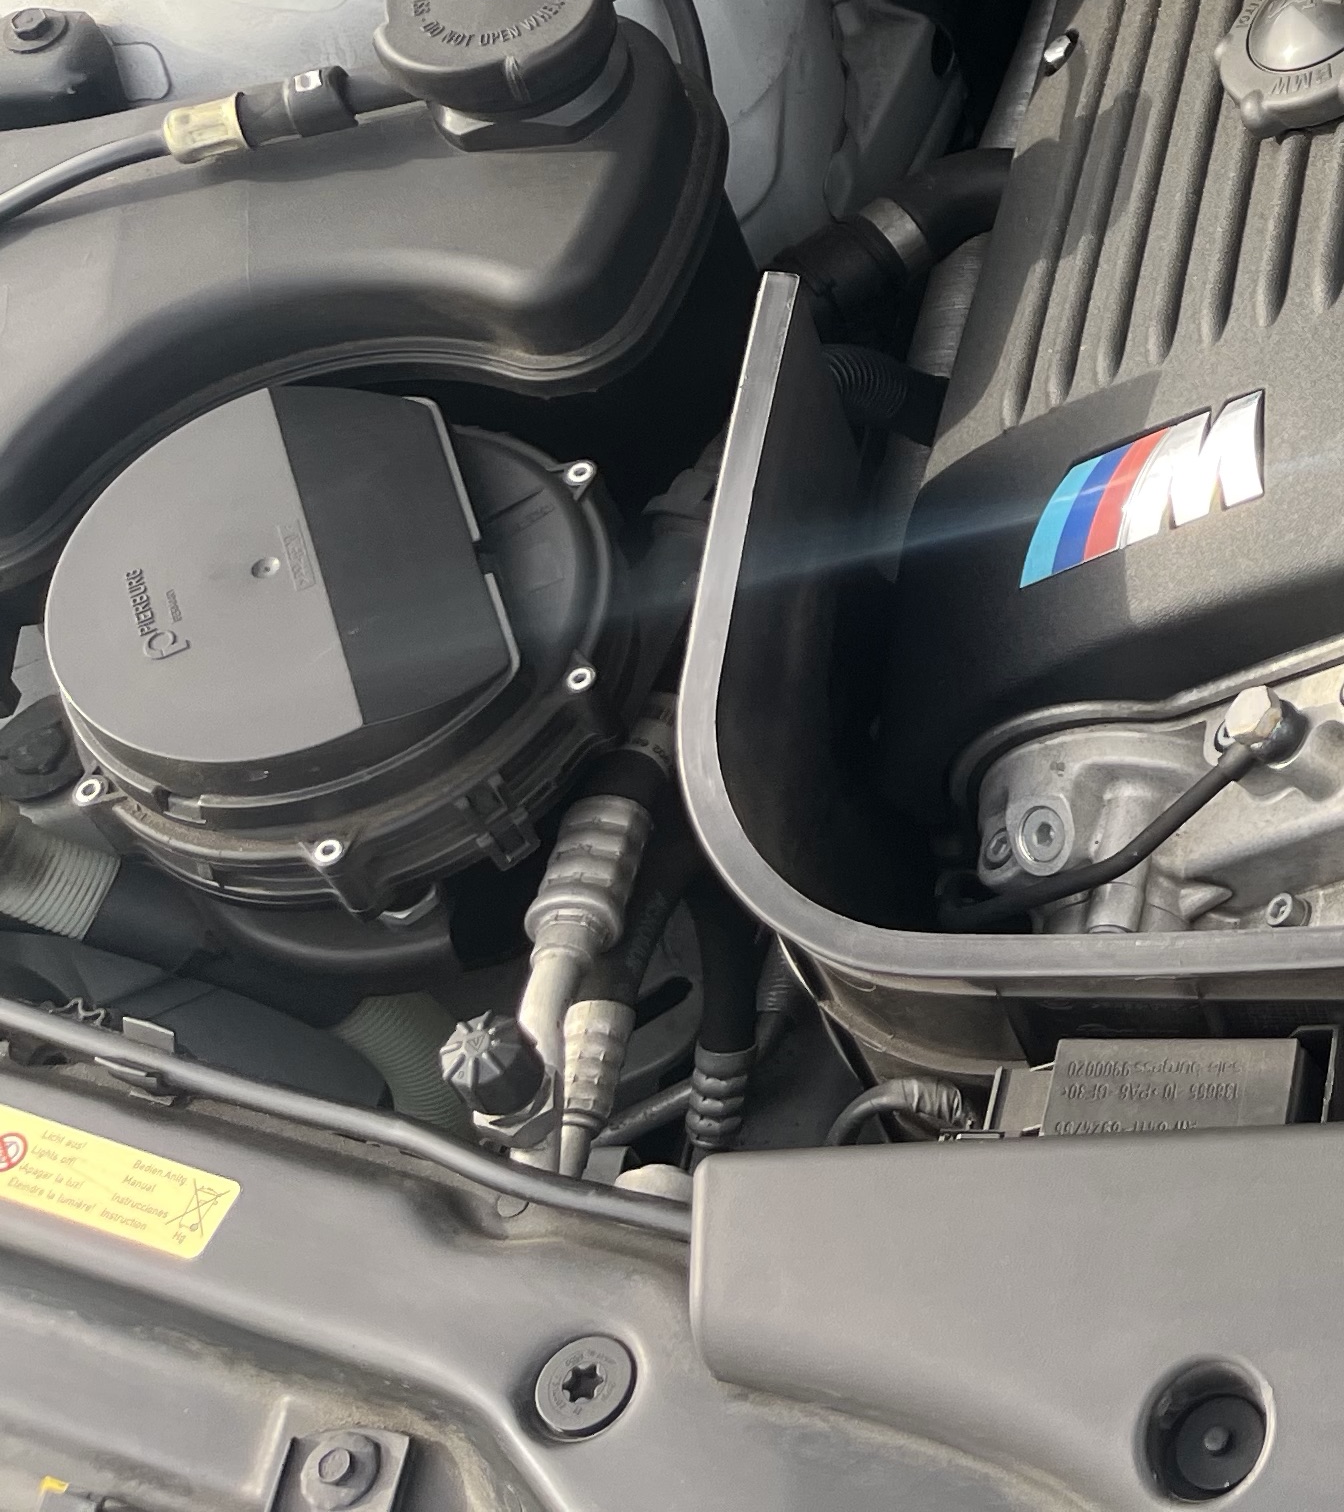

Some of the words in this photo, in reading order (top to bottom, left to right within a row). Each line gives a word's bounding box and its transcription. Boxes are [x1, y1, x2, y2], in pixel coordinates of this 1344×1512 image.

[420, 20, 446, 37] DO
[442, 30, 476, 48] NOT
[480, 25, 522, 47] OPEN
[41, 1130, 65, 1145] Licht
[31, 1144, 58, 1162] Lights
[122, 1175, 157, 1193] Manual
[100, 1207, 148, 1230] Instruction
[172, 1231, 187, 1244] Hg
